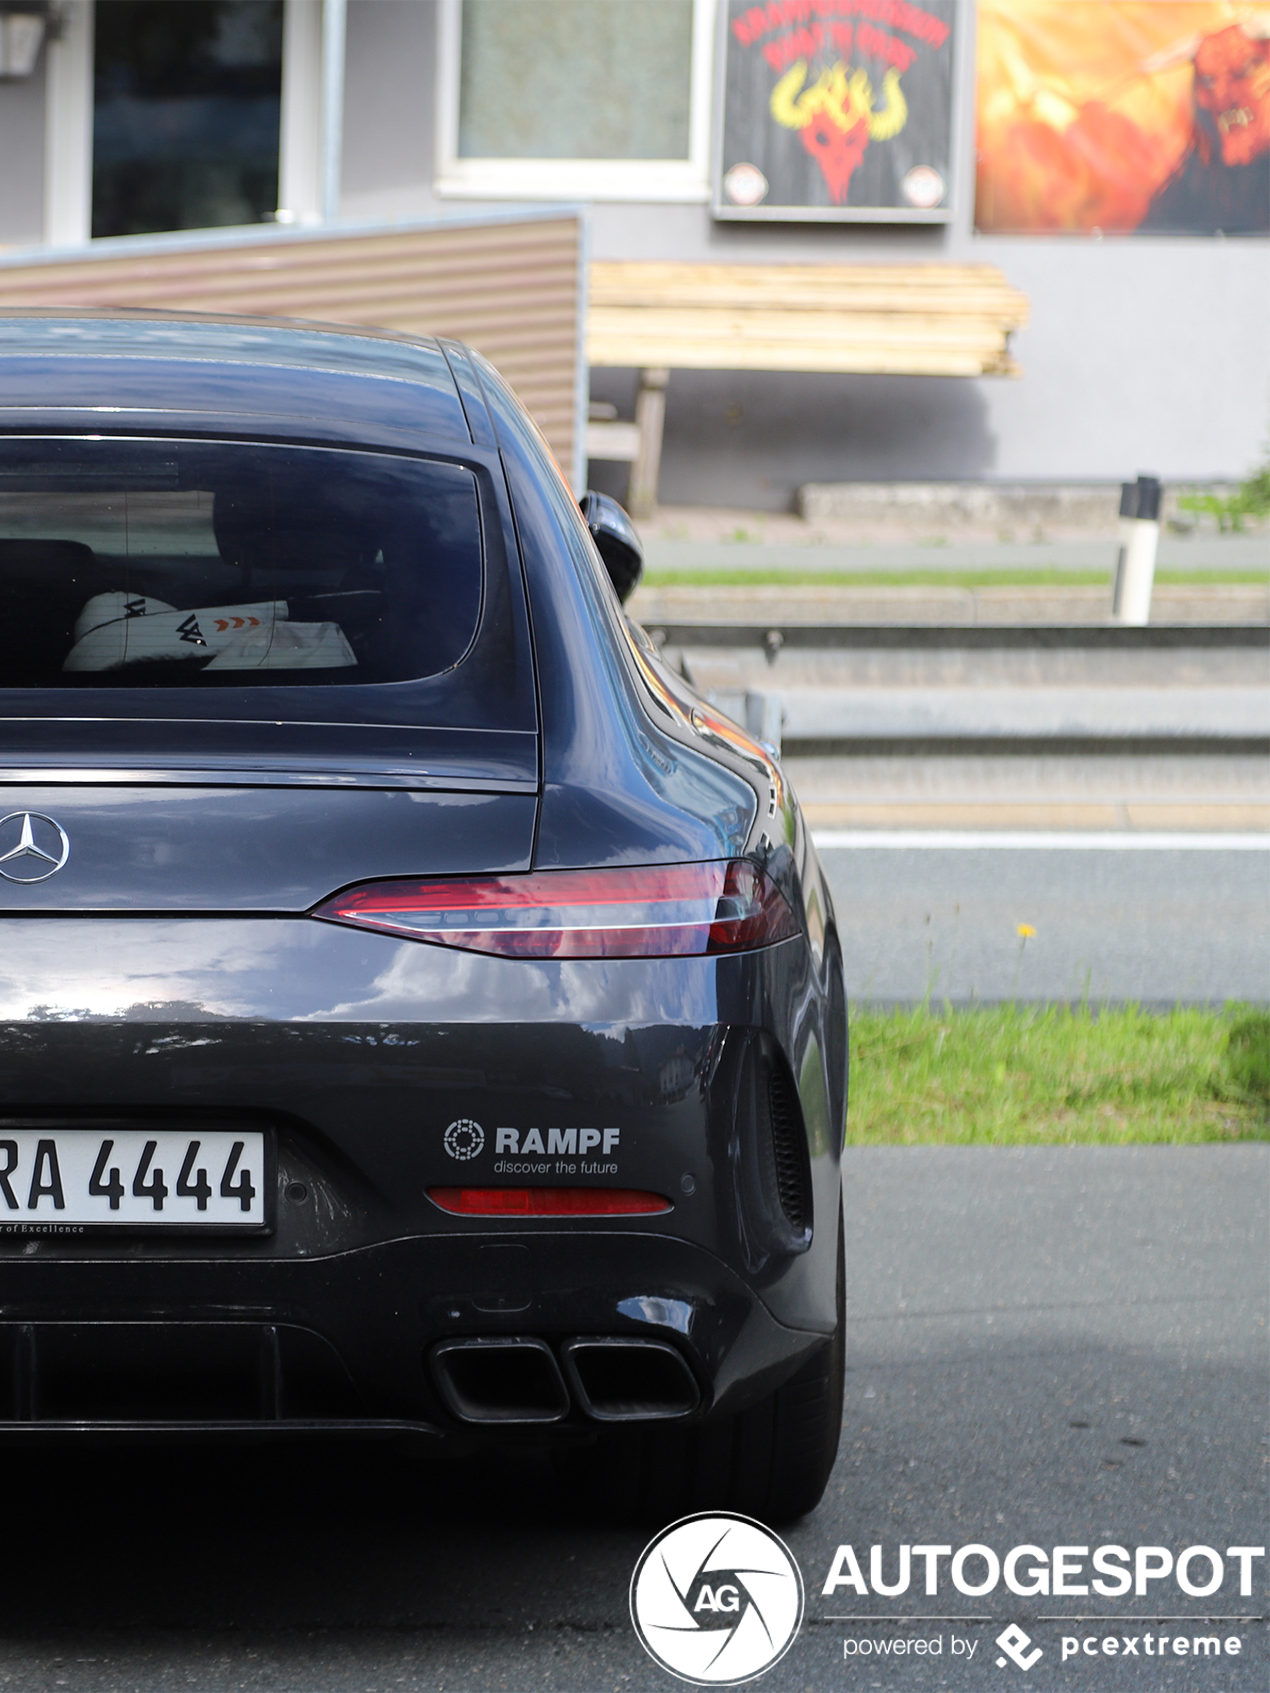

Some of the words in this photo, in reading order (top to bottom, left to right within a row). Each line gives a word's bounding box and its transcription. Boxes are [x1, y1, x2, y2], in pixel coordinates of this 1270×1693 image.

[495, 1127, 621, 1155] RAMPF
[88, 1139, 256, 1212] 4444
[493, 1160, 552, 1174] discover
[555, 1160, 577, 1174] the
[580, 1160, 618, 1174] future
[6, 1224, 18, 1233] of
[21, 1224, 84, 1233] Excellence
